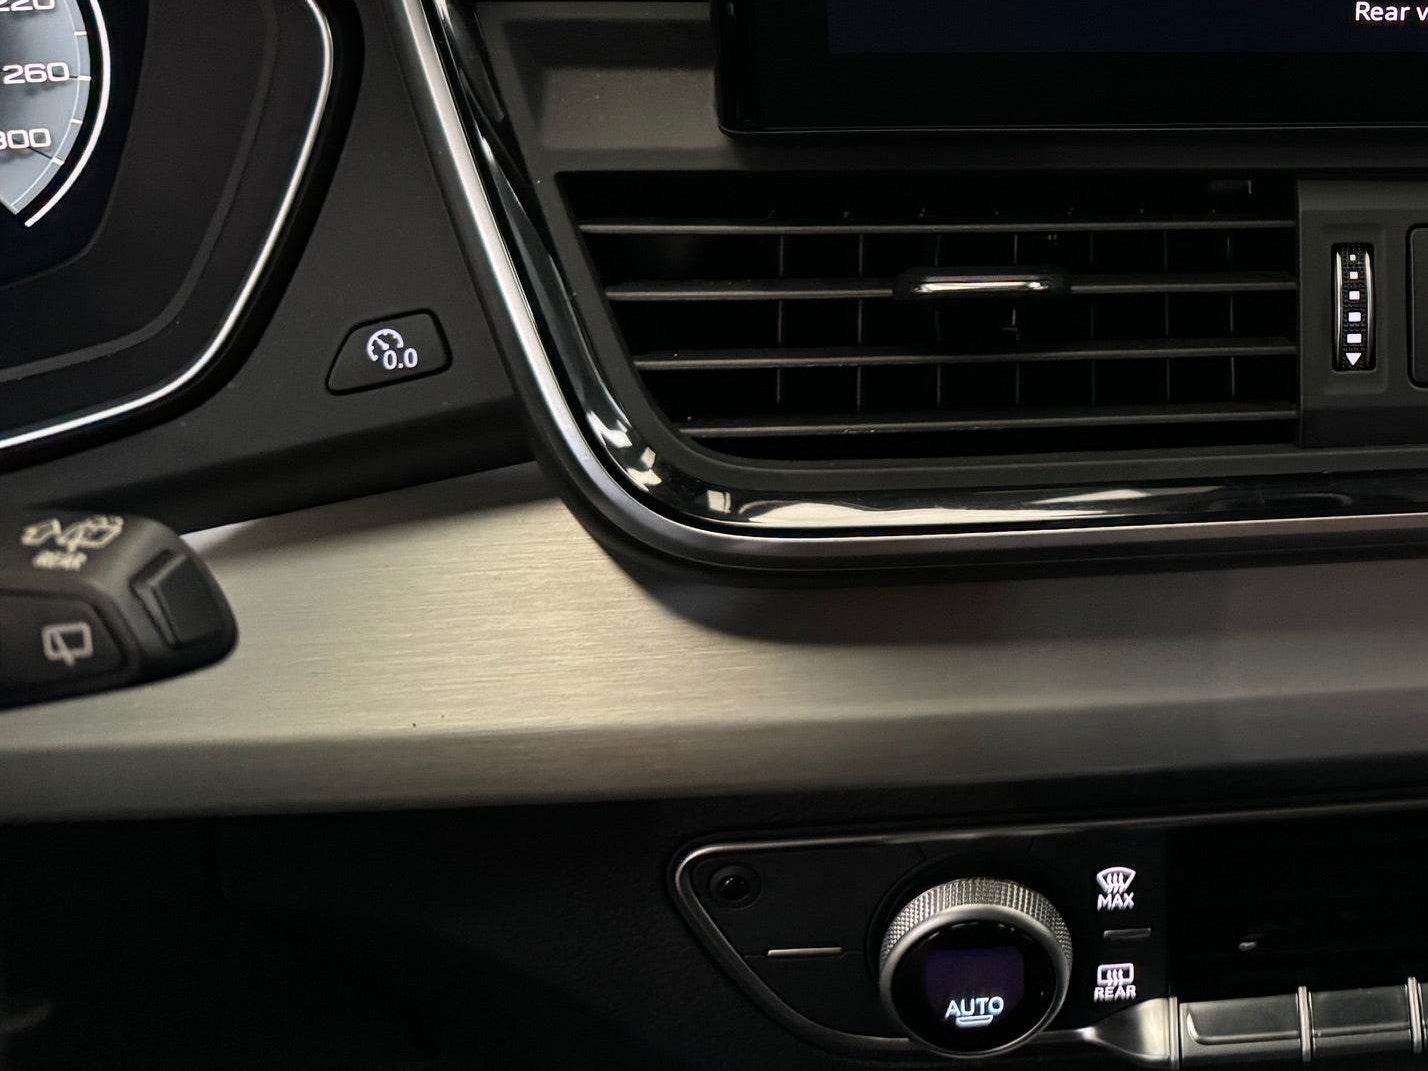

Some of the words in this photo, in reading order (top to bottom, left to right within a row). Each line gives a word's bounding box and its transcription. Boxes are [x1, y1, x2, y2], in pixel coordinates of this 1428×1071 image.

[1355, 1, 1410, 22] Rear
[2, 62, 70, 84] 260
[382, 347, 418, 370] 0.0
[1097, 893, 1135, 910] MAX
[1094, 985, 1137, 1002] REAR
[945, 996, 1005, 1018] AUTO
